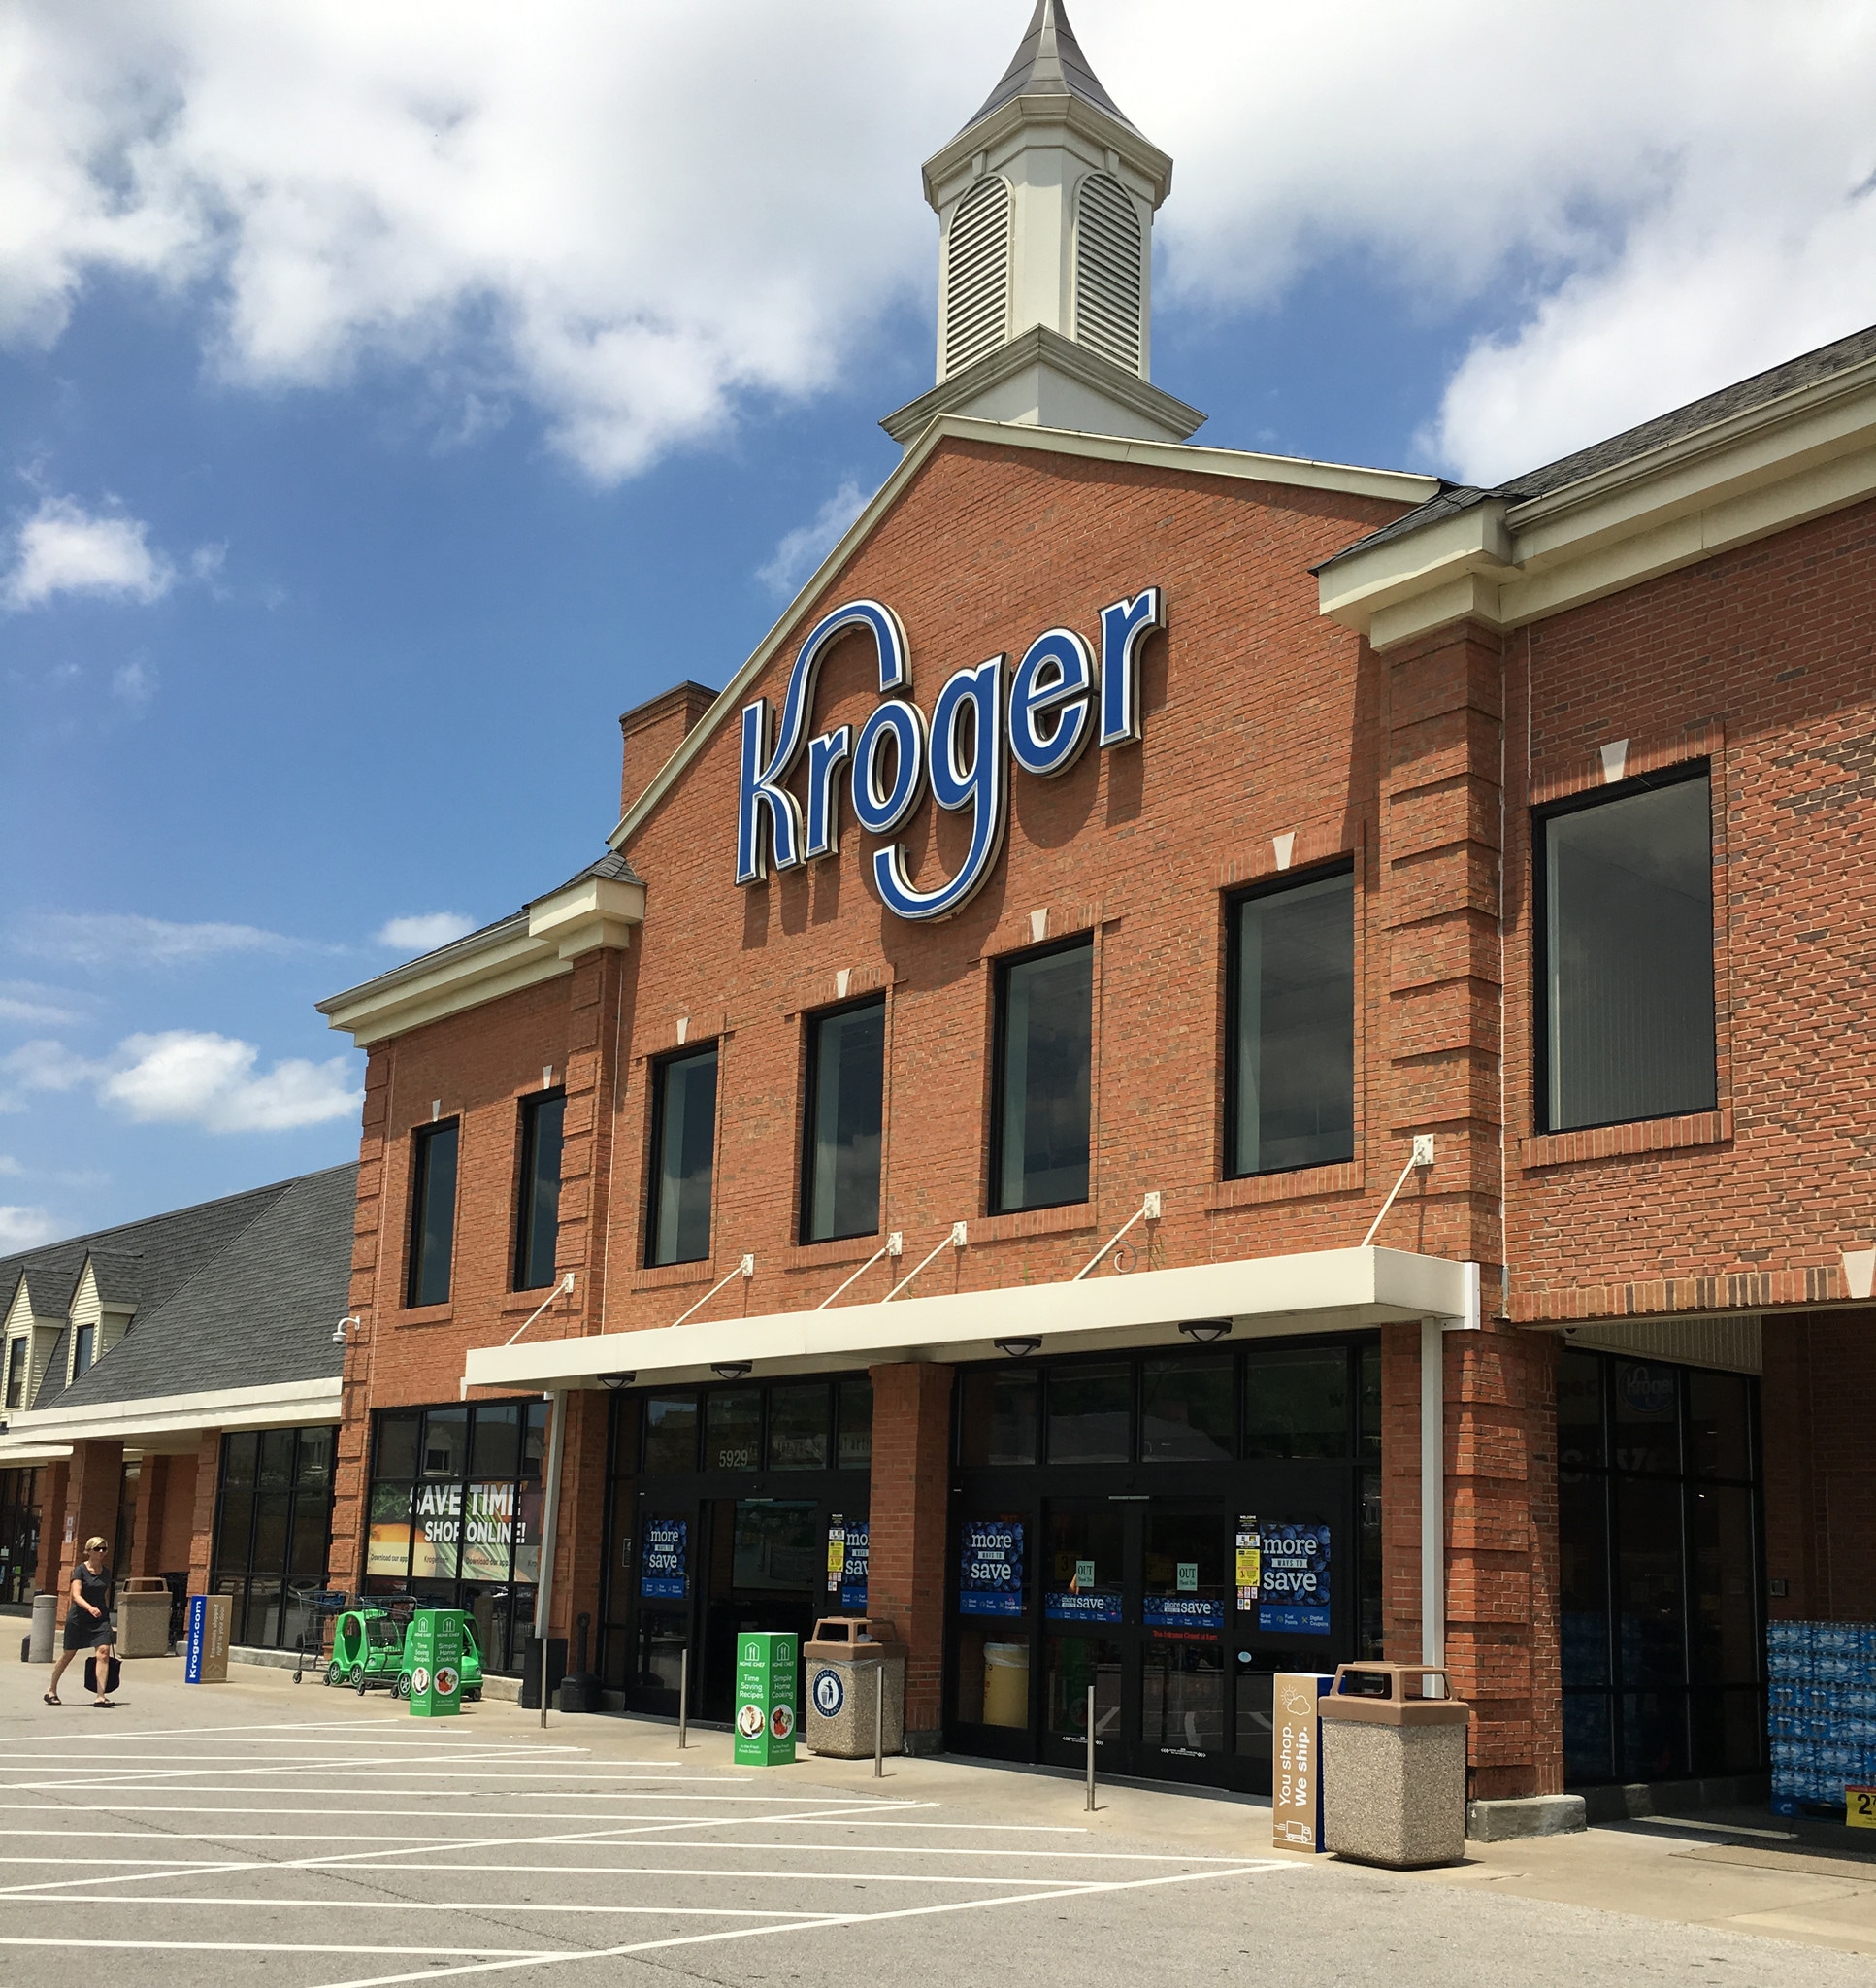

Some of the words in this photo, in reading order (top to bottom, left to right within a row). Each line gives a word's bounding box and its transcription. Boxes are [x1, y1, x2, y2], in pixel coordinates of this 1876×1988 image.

[735, 585, 1166, 922] Kroger
[719, 1449, 747, 1467] 5929
[424, 1520, 460, 1542] SHOP
[650, 1530, 678, 1542] more
[846, 1533, 870, 1546] mo
[971, 1534, 1012, 1548] more
[1263, 1539, 1317, 1555] more
[648, 1554, 677, 1569] save
[845, 1560, 869, 1575] sav
[971, 1562, 1011, 1580] save
[1077, 1565, 1093, 1575] OUT
[1179, 1568, 1195, 1578] OUT
[1263, 1572, 1317, 1592] save
[1076, 1598, 1104, 1609] save
[1181, 1602, 1212, 1614] save
[188, 1601, 202, 1678] Kroger.com
[743, 1673, 760, 1682] Time
[773, 1674, 792, 1683] Simple
[739, 1690, 764, 1699] Recipes
[741, 1682, 763, 1692] Saving
[1279, 1721, 1295, 1770] shop.
[1295, 1726, 1311, 1773] ship.
[1278, 1773, 1292, 1806] You
[1295, 1777, 1308, 1806] We
